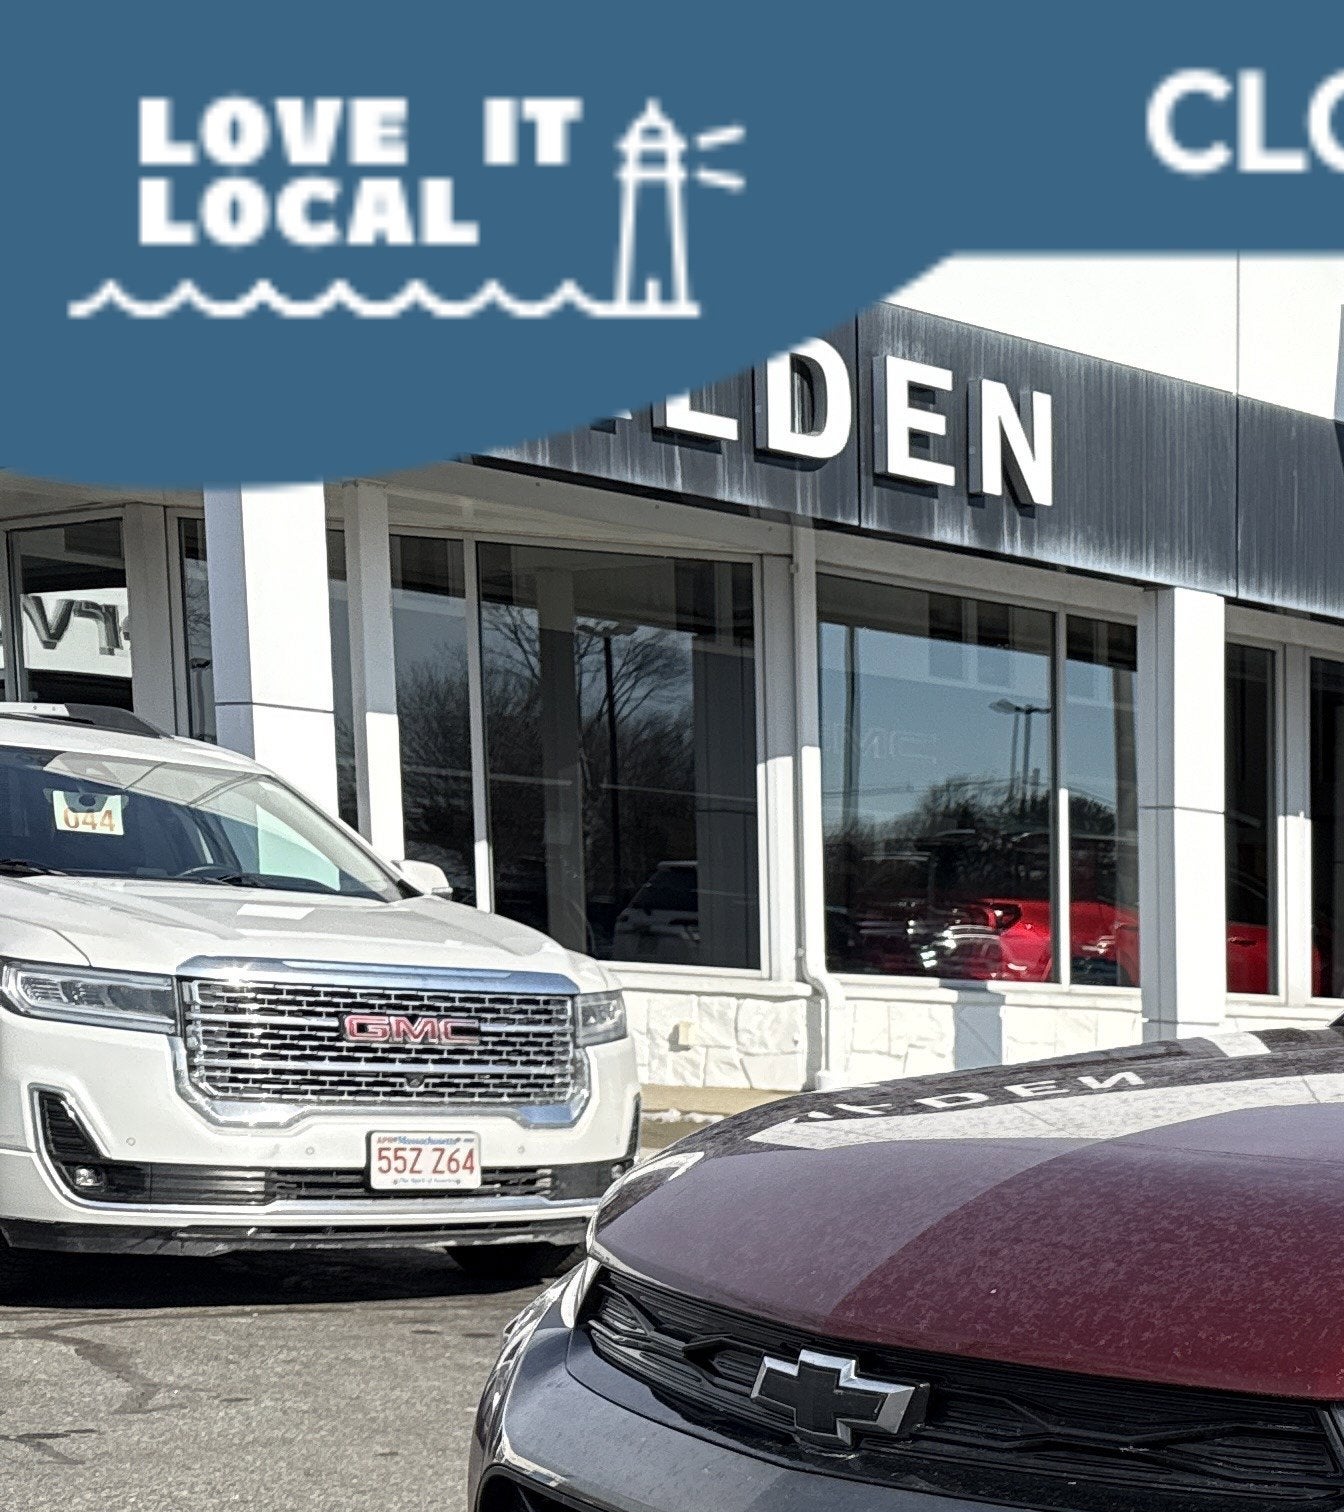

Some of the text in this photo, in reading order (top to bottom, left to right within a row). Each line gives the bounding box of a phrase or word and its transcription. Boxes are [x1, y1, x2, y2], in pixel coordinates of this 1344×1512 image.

[344, 1014, 480, 1046] GMC
[377, 1146, 475, 1175] 55Z Z64
